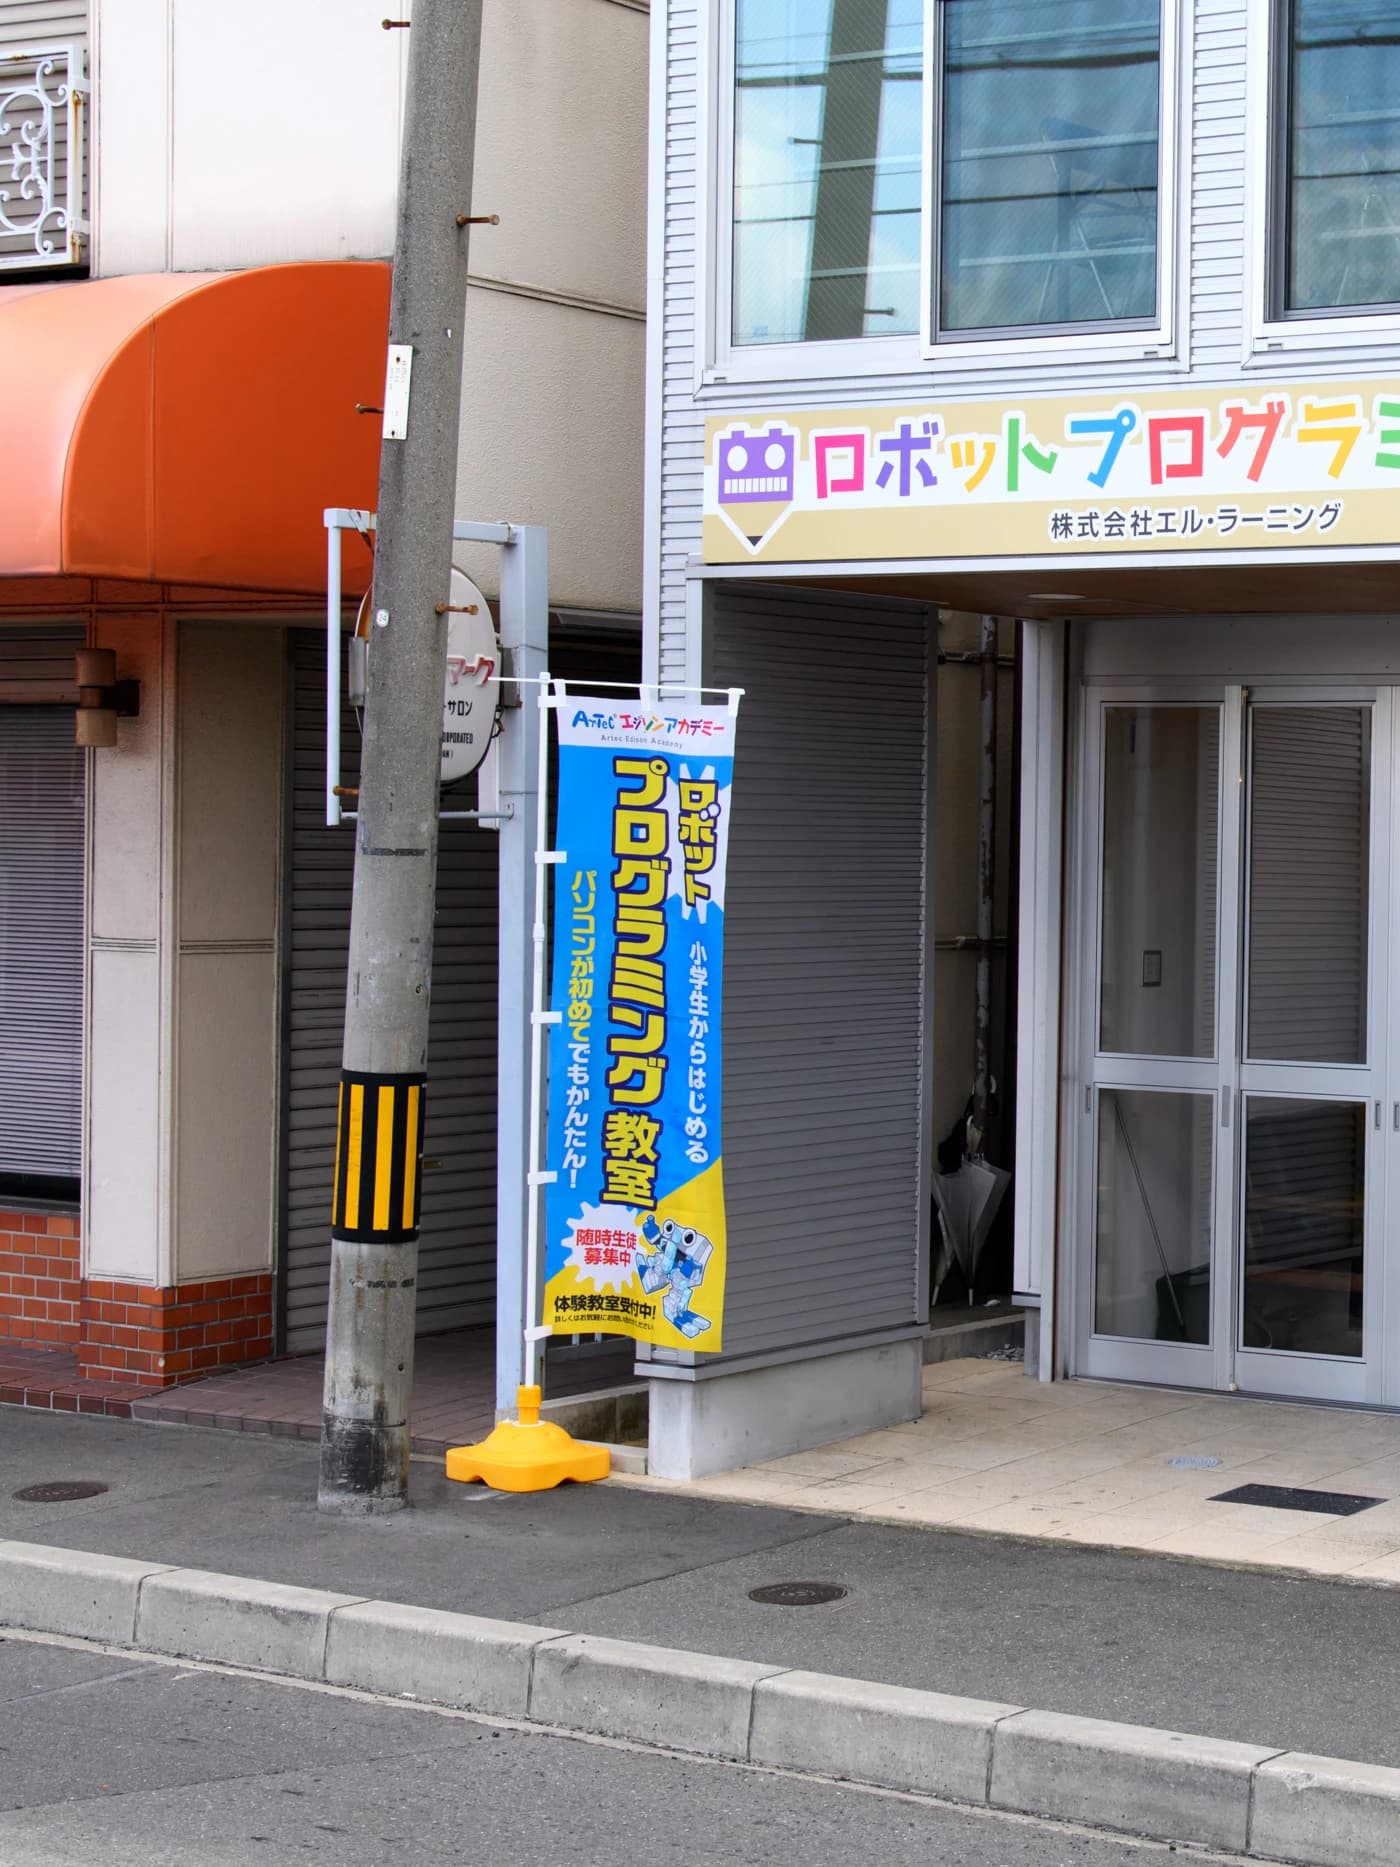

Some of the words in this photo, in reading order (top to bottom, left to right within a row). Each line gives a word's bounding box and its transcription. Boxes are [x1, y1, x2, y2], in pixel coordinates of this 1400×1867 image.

[1051, 502, 1341, 540] 株式会社エル・ラーニング
[444, 700, 473, 717] サロン
[620, 714, 724, 736] エジソンアカデミー
[678, 778, 720, 907] ロボット
[600, 756, 672, 1209] プログラミング教室
[684, 941, 708, 1164] 小学生からはじめる
[576, 1229, 637, 1251] 随時生徒
[584, 1247, 631, 1267] 募集中
[554, 1295, 656, 1319] 体験教室受付中!
